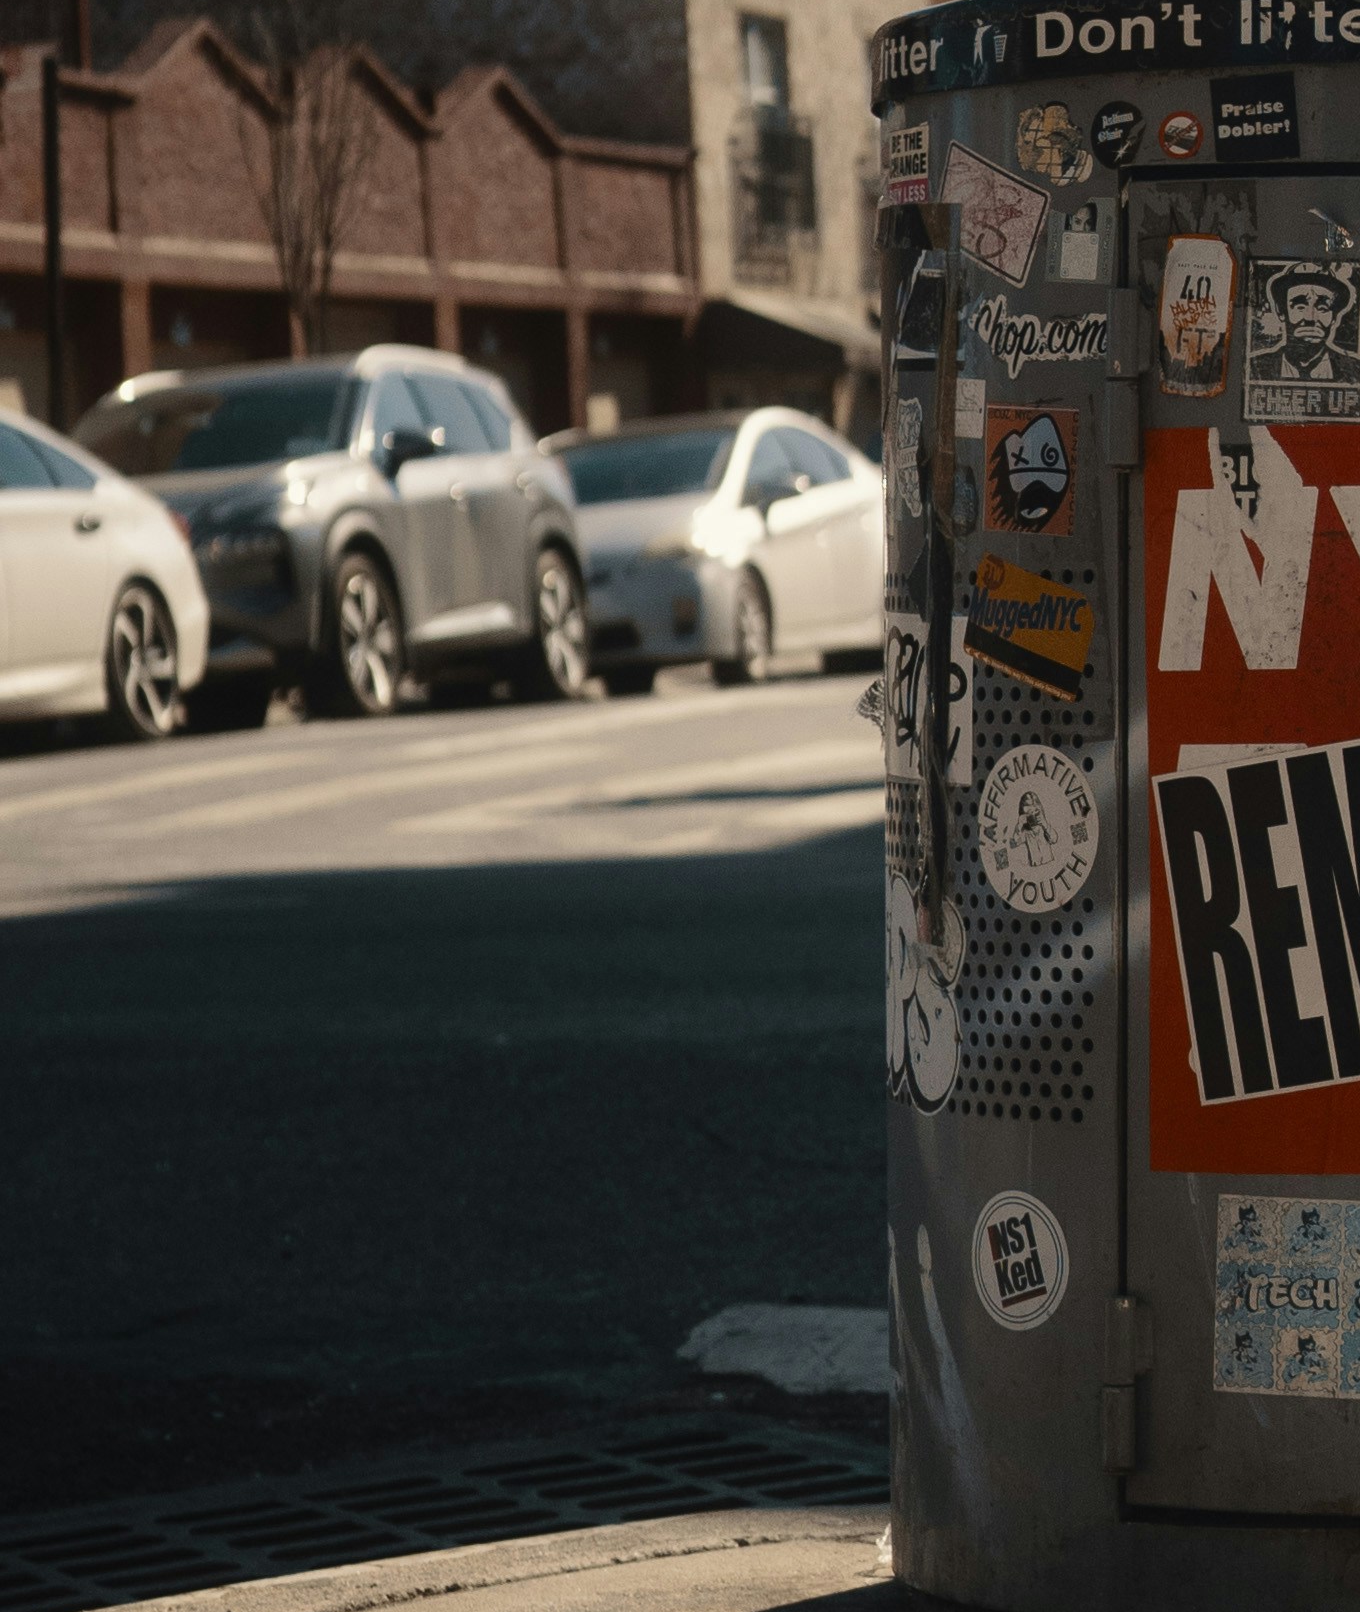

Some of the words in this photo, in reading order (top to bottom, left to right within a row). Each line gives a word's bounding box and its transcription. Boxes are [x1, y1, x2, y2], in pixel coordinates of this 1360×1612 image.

[1035, 1, 1203, 58] Don't
[879, 36, 944, 82] litter
[1221, 101, 1284, 118] Praise
[904, 131, 923, 151] THE
[1218, 119, 1290, 139] Dobler!
[903, 184, 926, 204] LESS
[1252, 388, 1322, 414] CHEER
[983, 752, 1091, 844] AFFIRMATIVE
[1006, 851, 1087, 905] YOUTH
[1243, 1274, 1340, 1314] TECH
